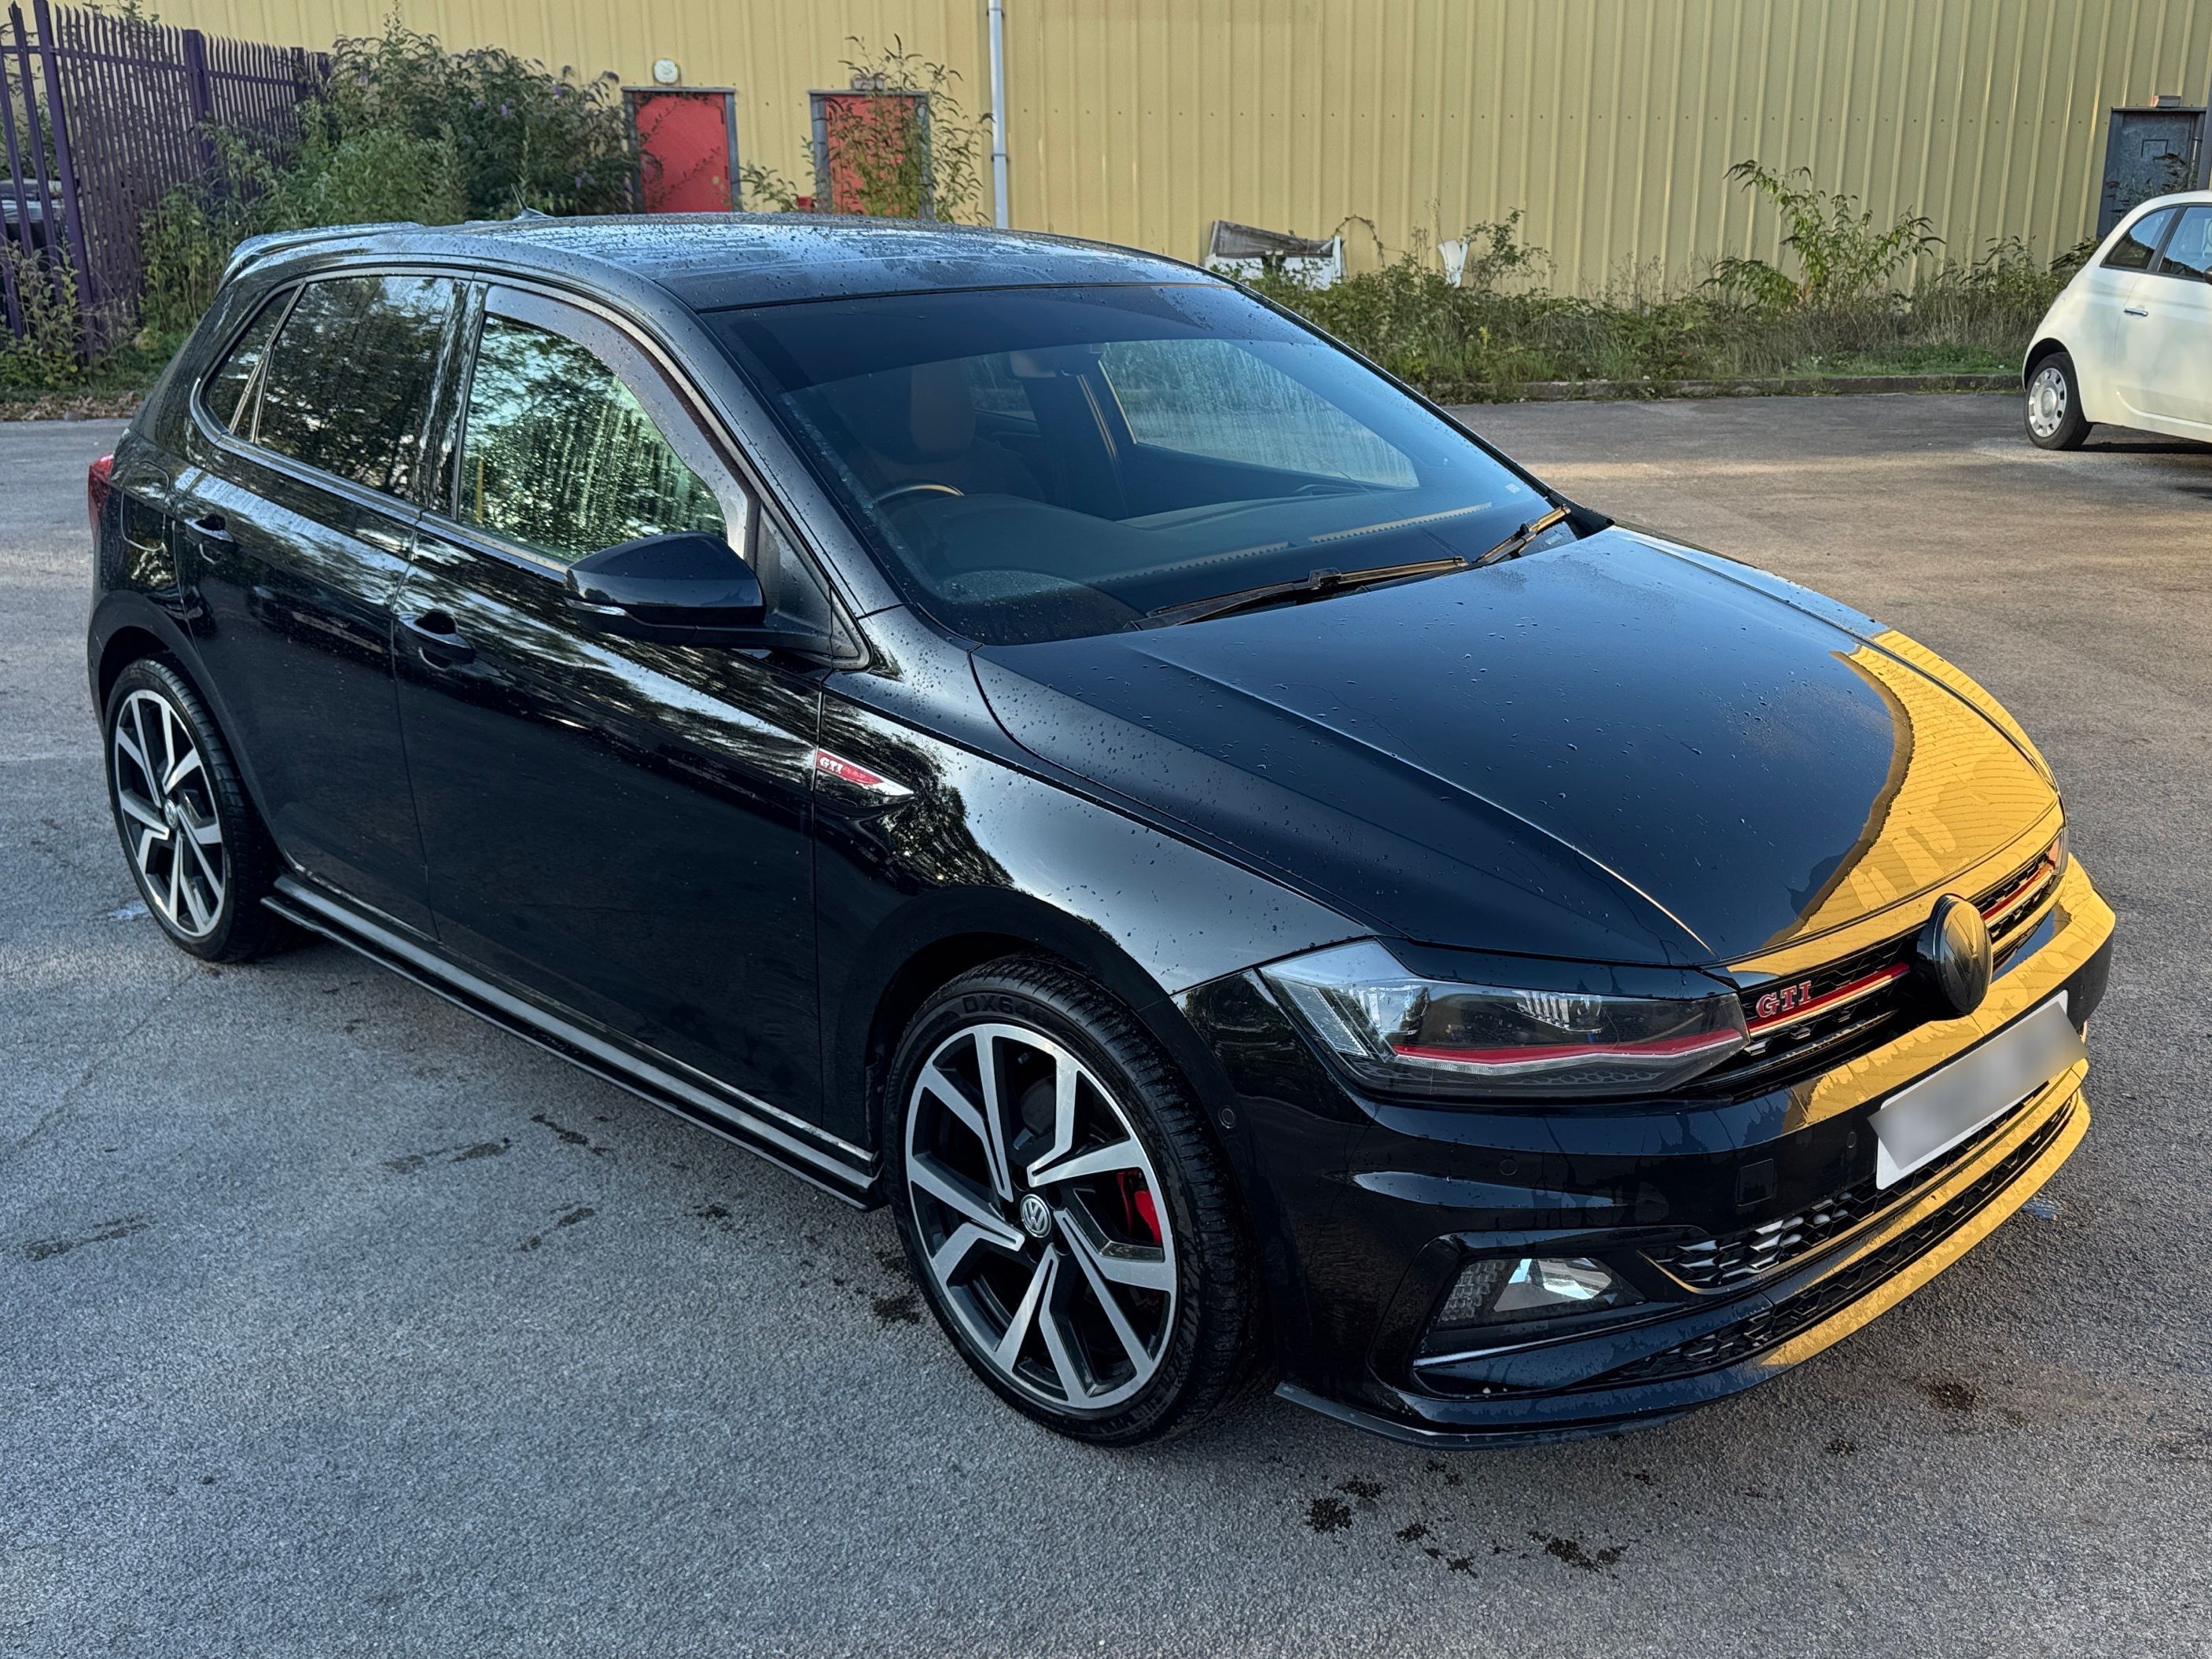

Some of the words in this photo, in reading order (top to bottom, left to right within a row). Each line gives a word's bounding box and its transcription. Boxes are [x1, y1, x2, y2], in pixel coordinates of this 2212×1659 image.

[819, 756, 843, 774] GTI
[1756, 980, 1812, 1018] GTI
[1022, 1196, 1050, 1235] VW
